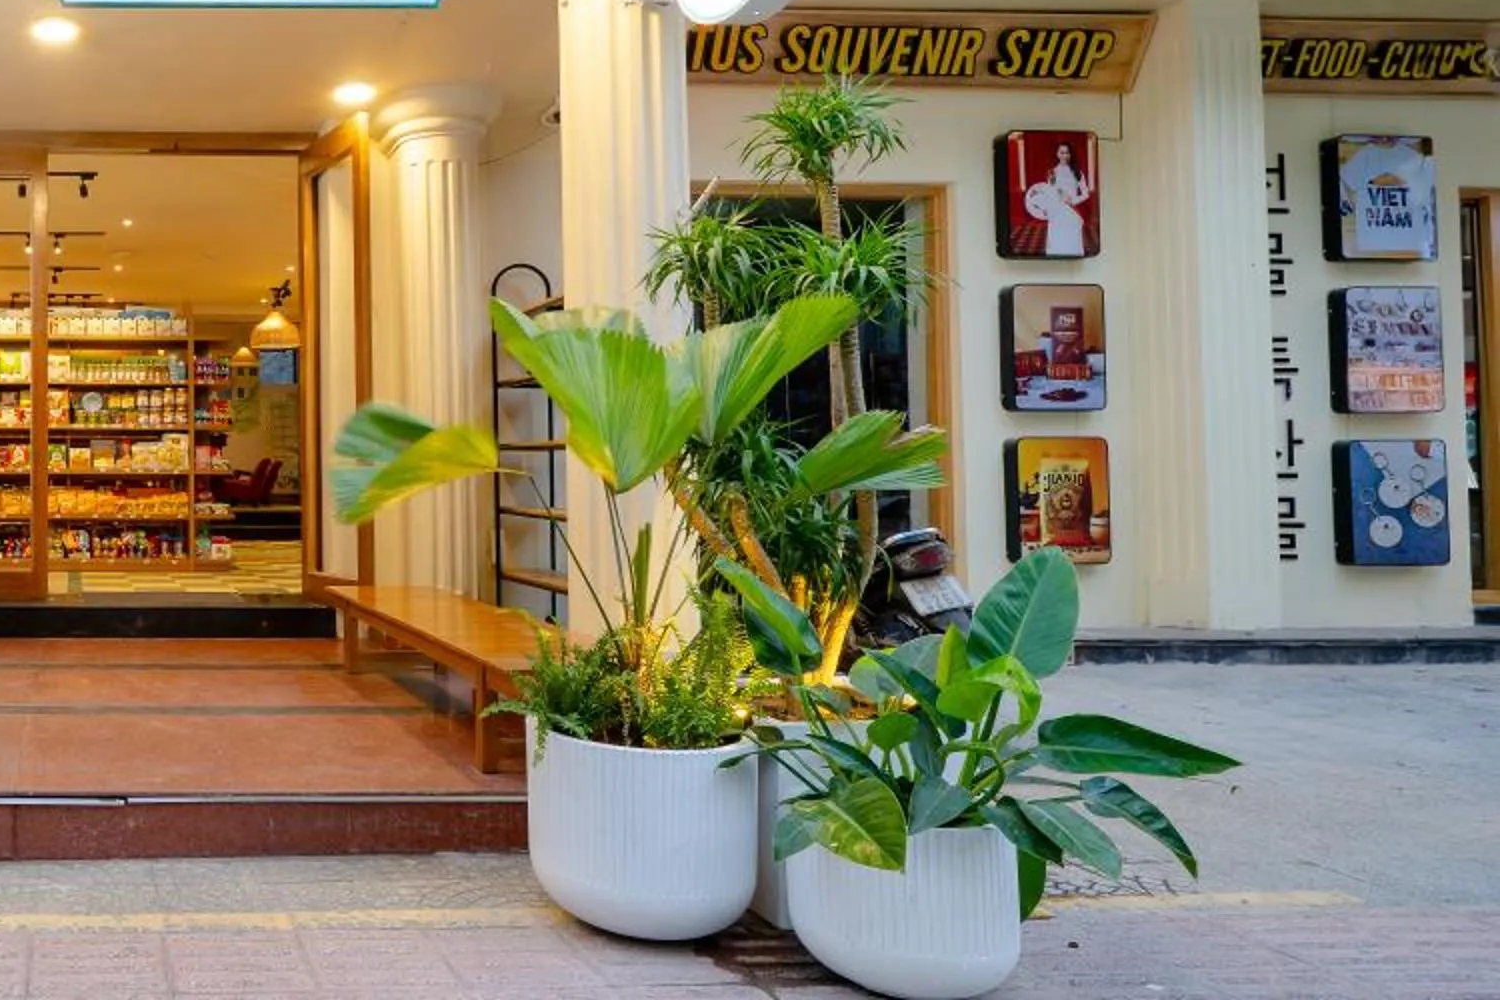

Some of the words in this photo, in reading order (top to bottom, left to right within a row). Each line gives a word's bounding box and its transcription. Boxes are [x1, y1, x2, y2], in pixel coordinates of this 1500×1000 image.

[779, 24, 986, 78] SOUVENIR
[997, 27, 1118, 79] SHOP
[1367, 187, 1410, 207] VIET
[1365, 206, 1413, 229] NAM
